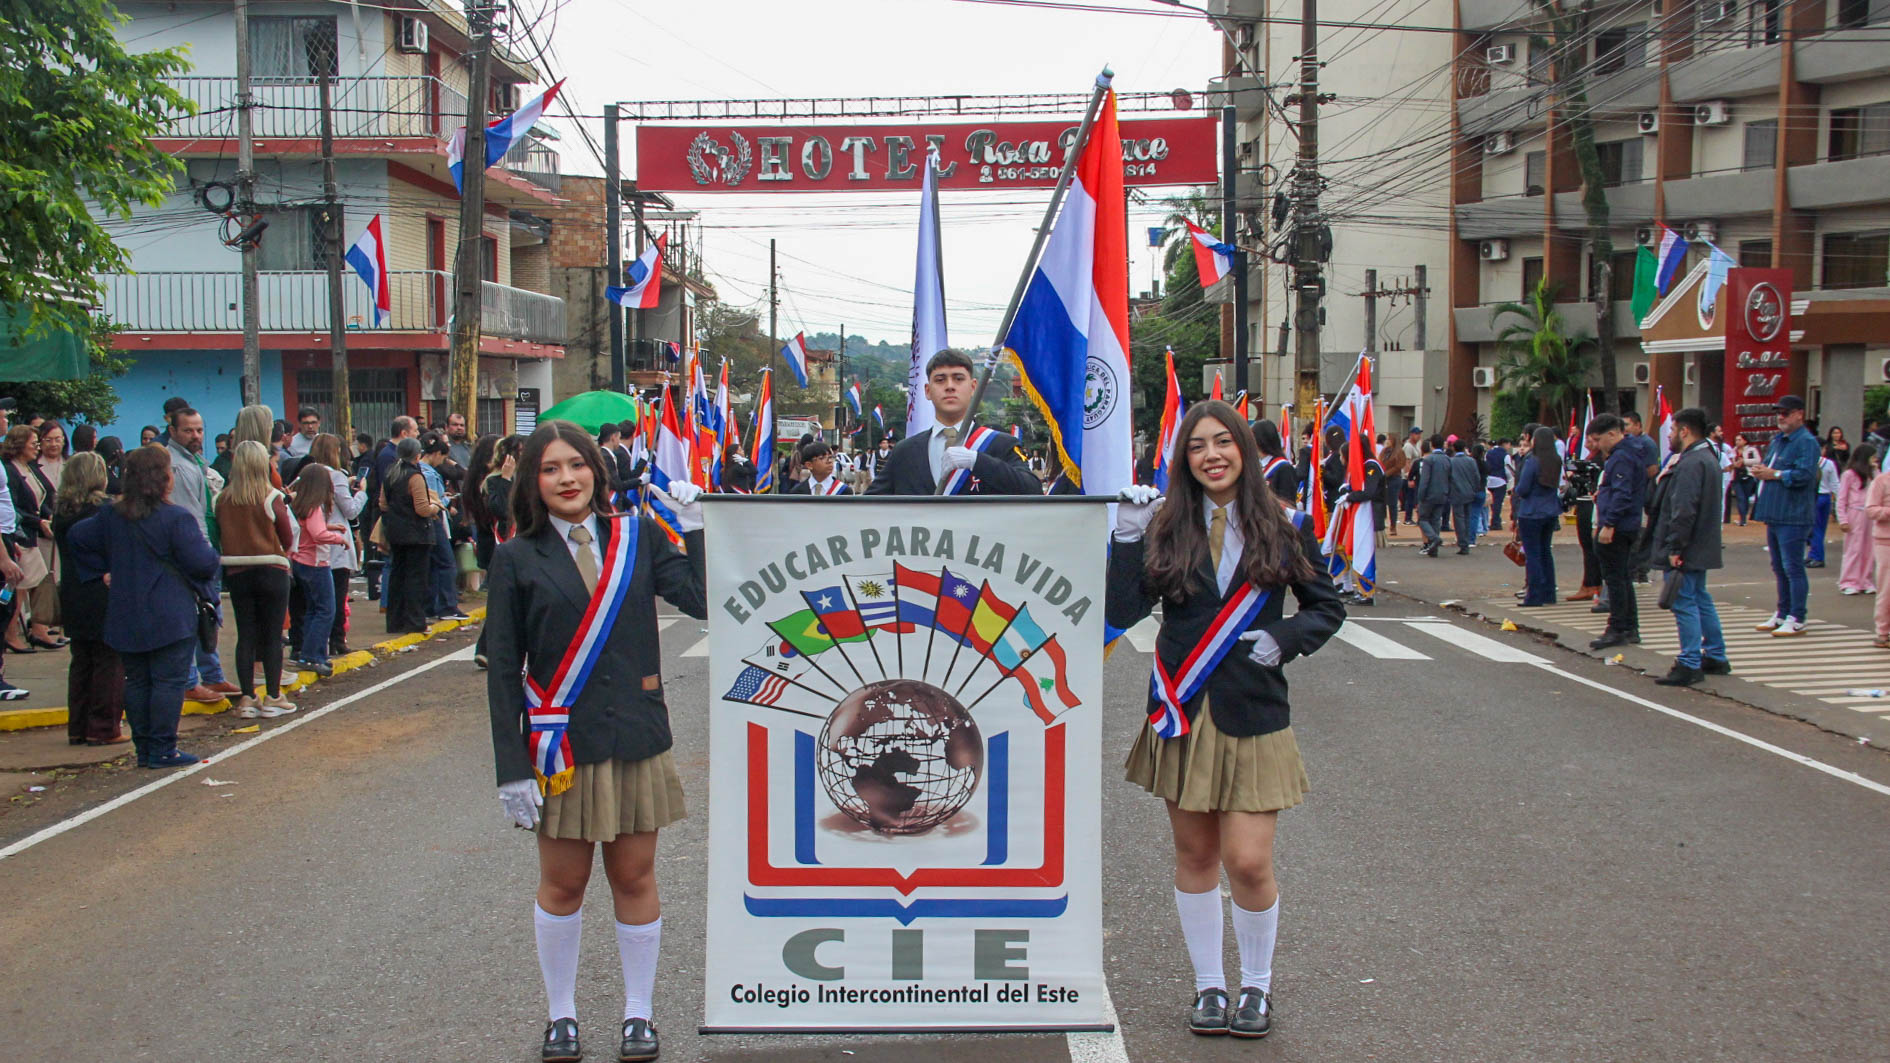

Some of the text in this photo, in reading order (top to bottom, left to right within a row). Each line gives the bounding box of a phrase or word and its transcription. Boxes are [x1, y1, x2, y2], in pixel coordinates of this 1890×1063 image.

[758, 135, 958, 181] HOTEL
[965, 129, 1051, 165] Rosa
[723, 526, 1093, 627] EDUCAR PARA LA VIDA
[782, 928, 1030, 981] CIE
[730, 983, 1080, 1008] Colegio Intercontinental del Este
